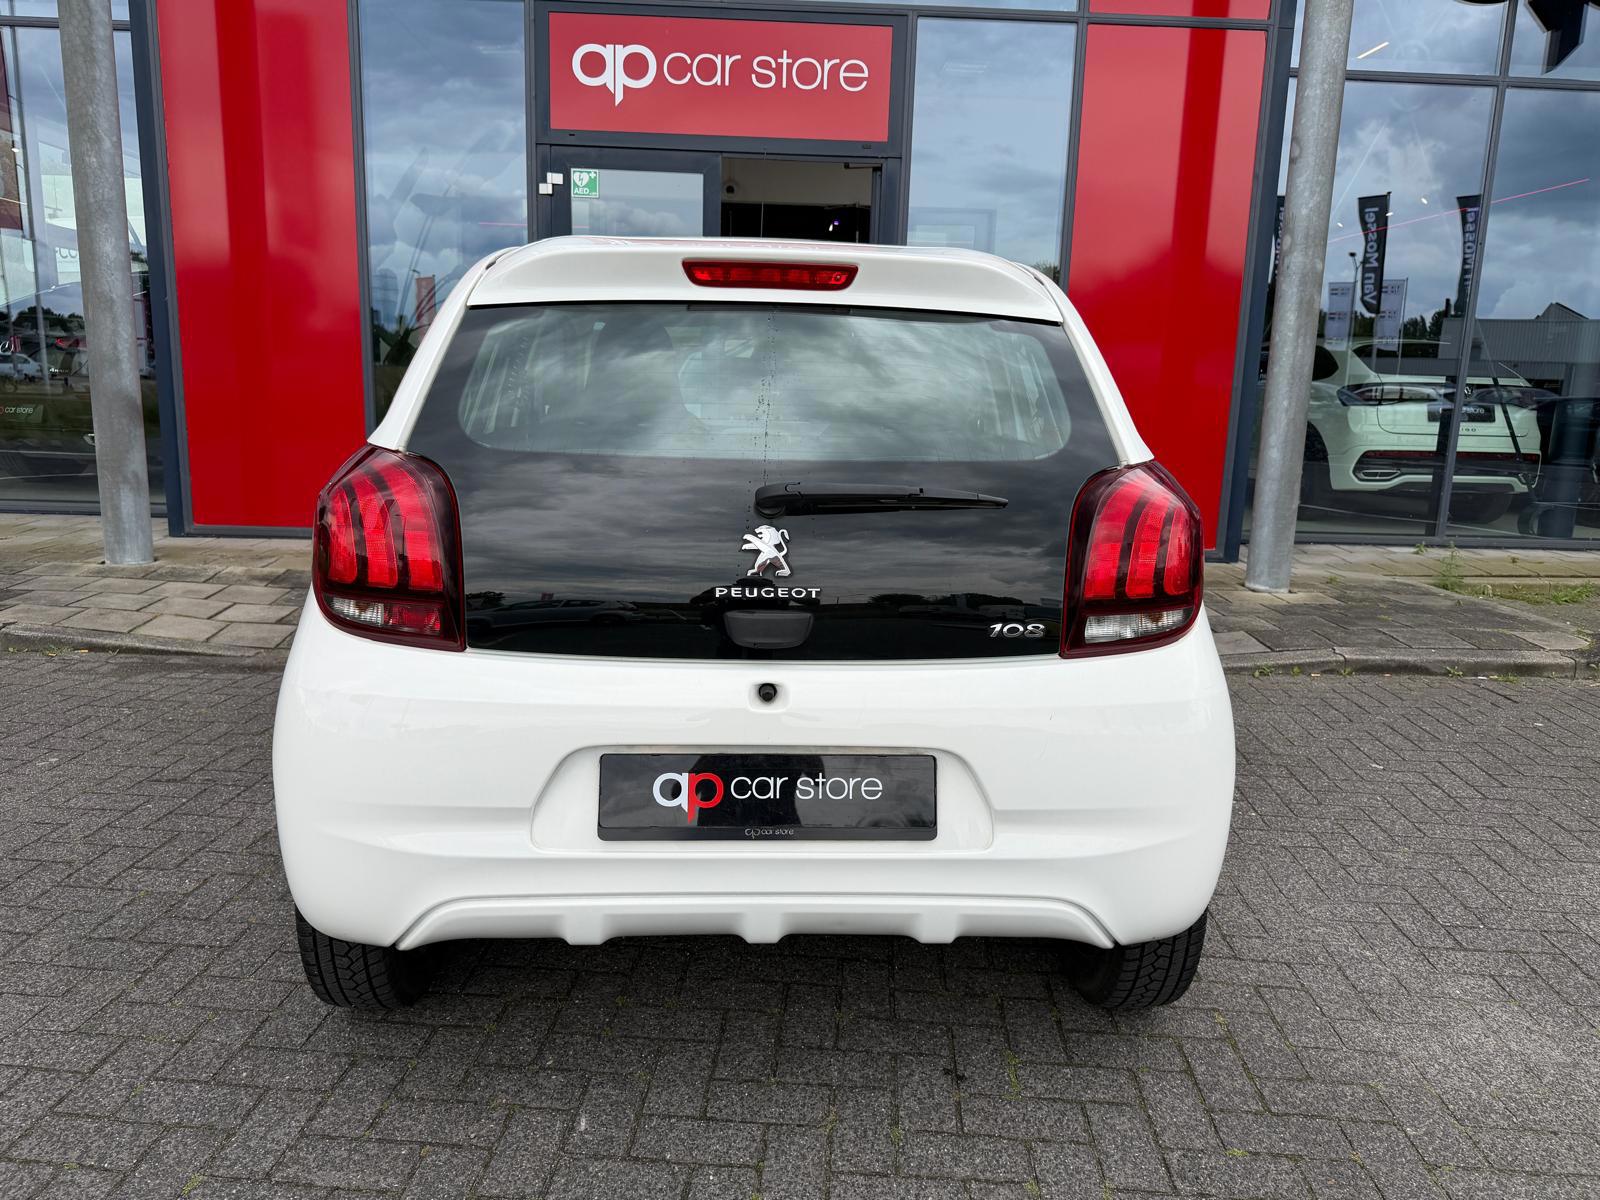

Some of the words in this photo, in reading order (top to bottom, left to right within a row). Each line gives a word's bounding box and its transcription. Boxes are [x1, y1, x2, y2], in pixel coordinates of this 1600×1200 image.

[663, 52, 741, 87] car
[751, 49, 869, 92] store
[574, 187, 590, 195] AED
[715, 587, 821, 598] PEUGEOT
[990, 623, 1045, 638] 108
[730, 776, 789, 800] car
[795, 772, 883, 800] store
